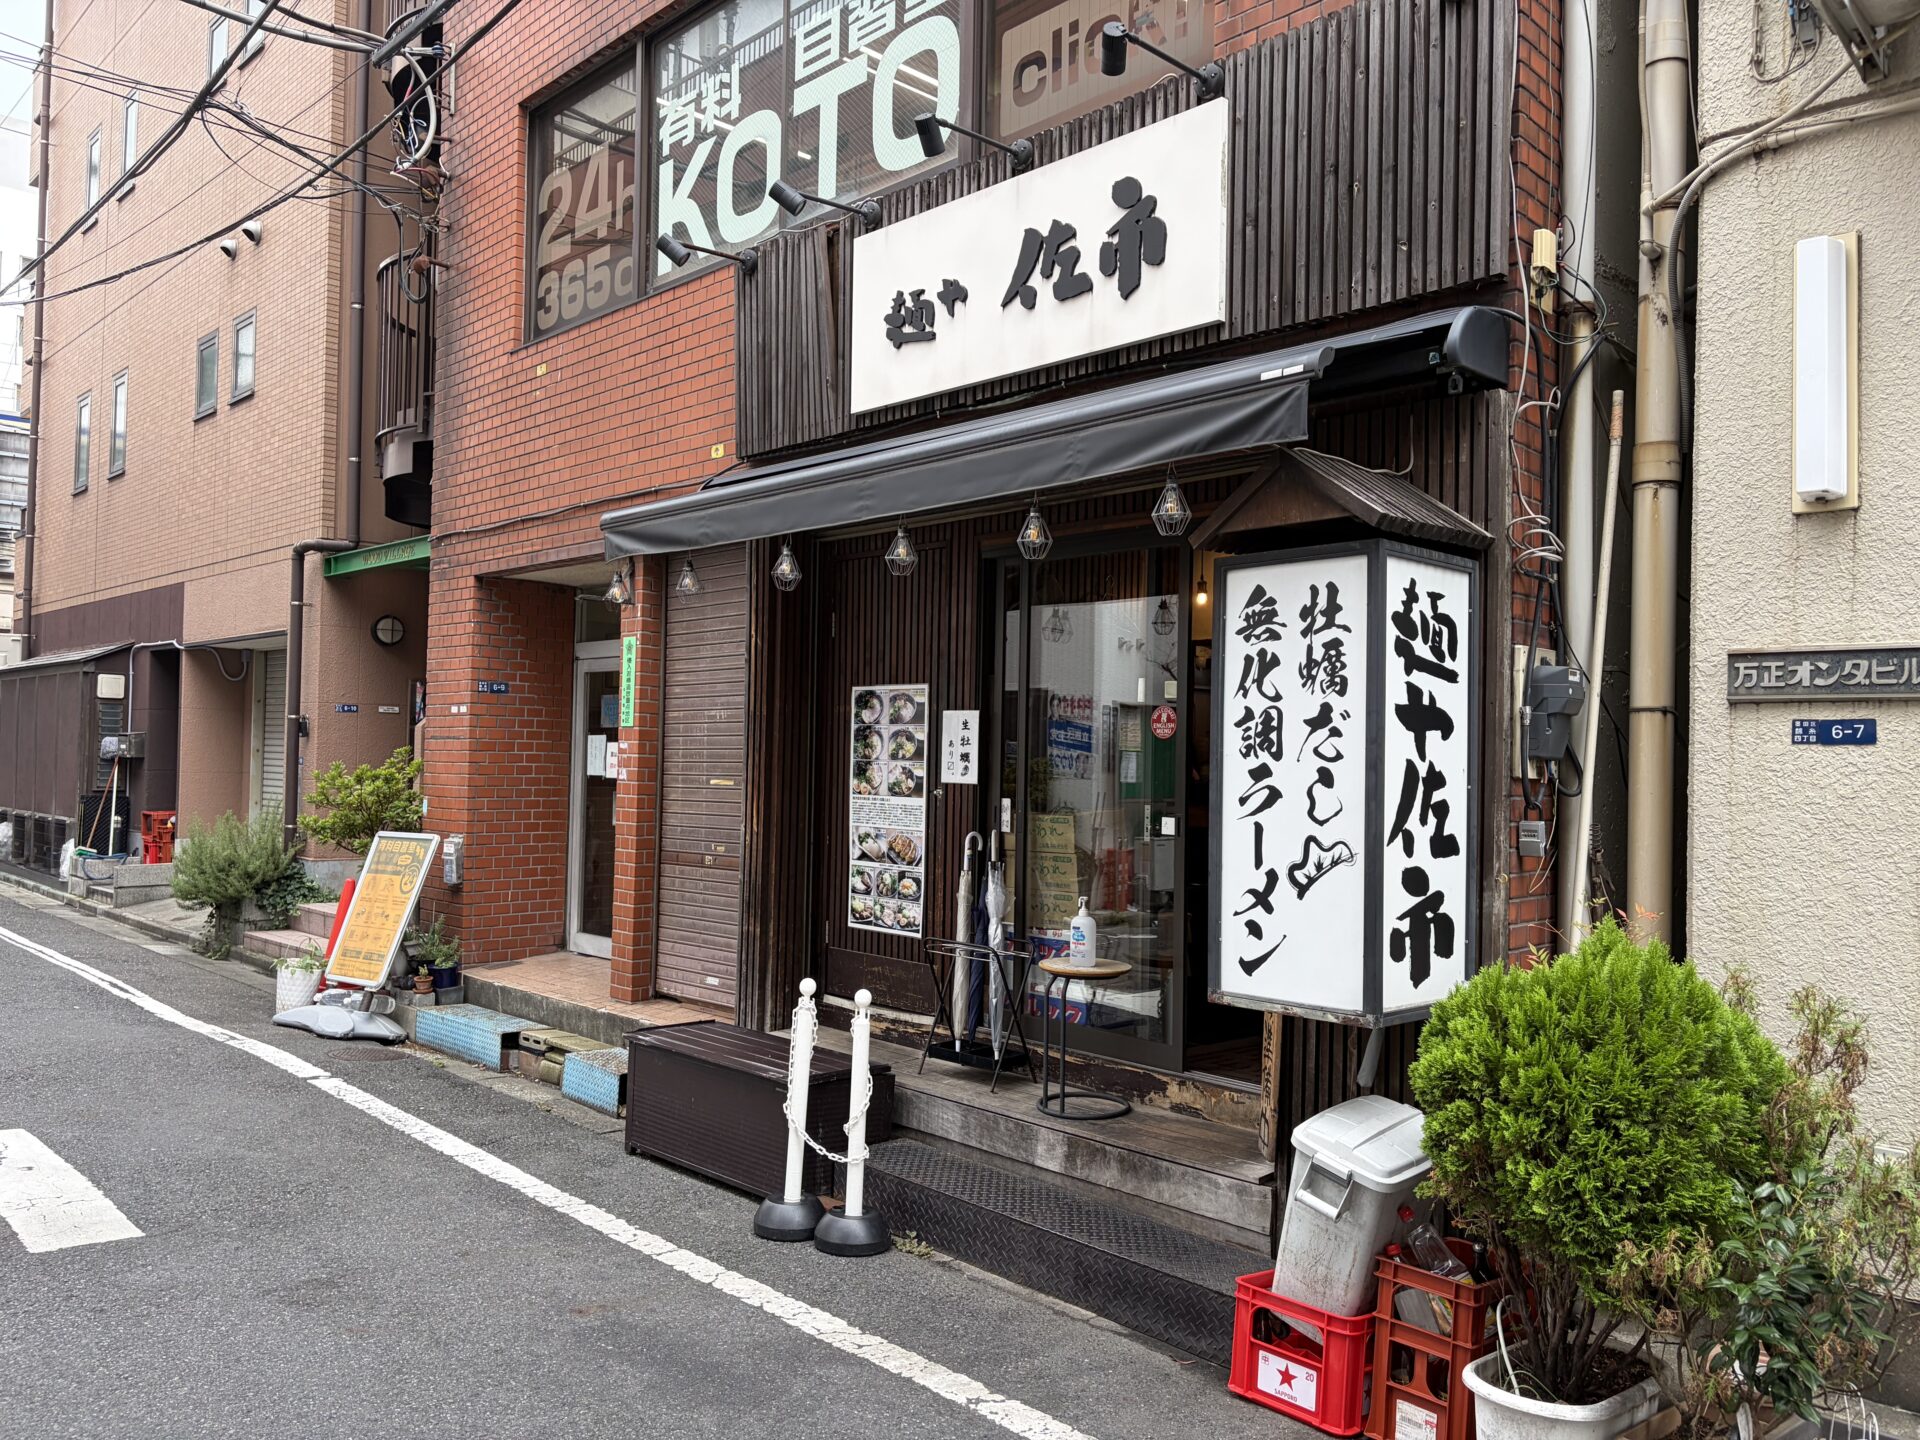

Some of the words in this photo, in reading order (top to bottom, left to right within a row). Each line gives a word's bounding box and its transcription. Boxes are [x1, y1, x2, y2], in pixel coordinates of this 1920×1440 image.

[657, 15, 960, 276] KOTO
[658, 62, 742, 158] 有料
[883, 278, 968, 350] 麺や
[1000, 176, 1167, 310] 佐市
[1233, 584, 1288, 977] 無化調ラーメン
[1296, 581, 1352, 827] 牡蠣だし
[1386, 577, 1460, 990] 麺や佐市
[1831, 724, 1865, 739] 6-7
[1274, 1388, 1298, 1403] SAPPORO
[1305, 1371, 1315, 1383] 20
